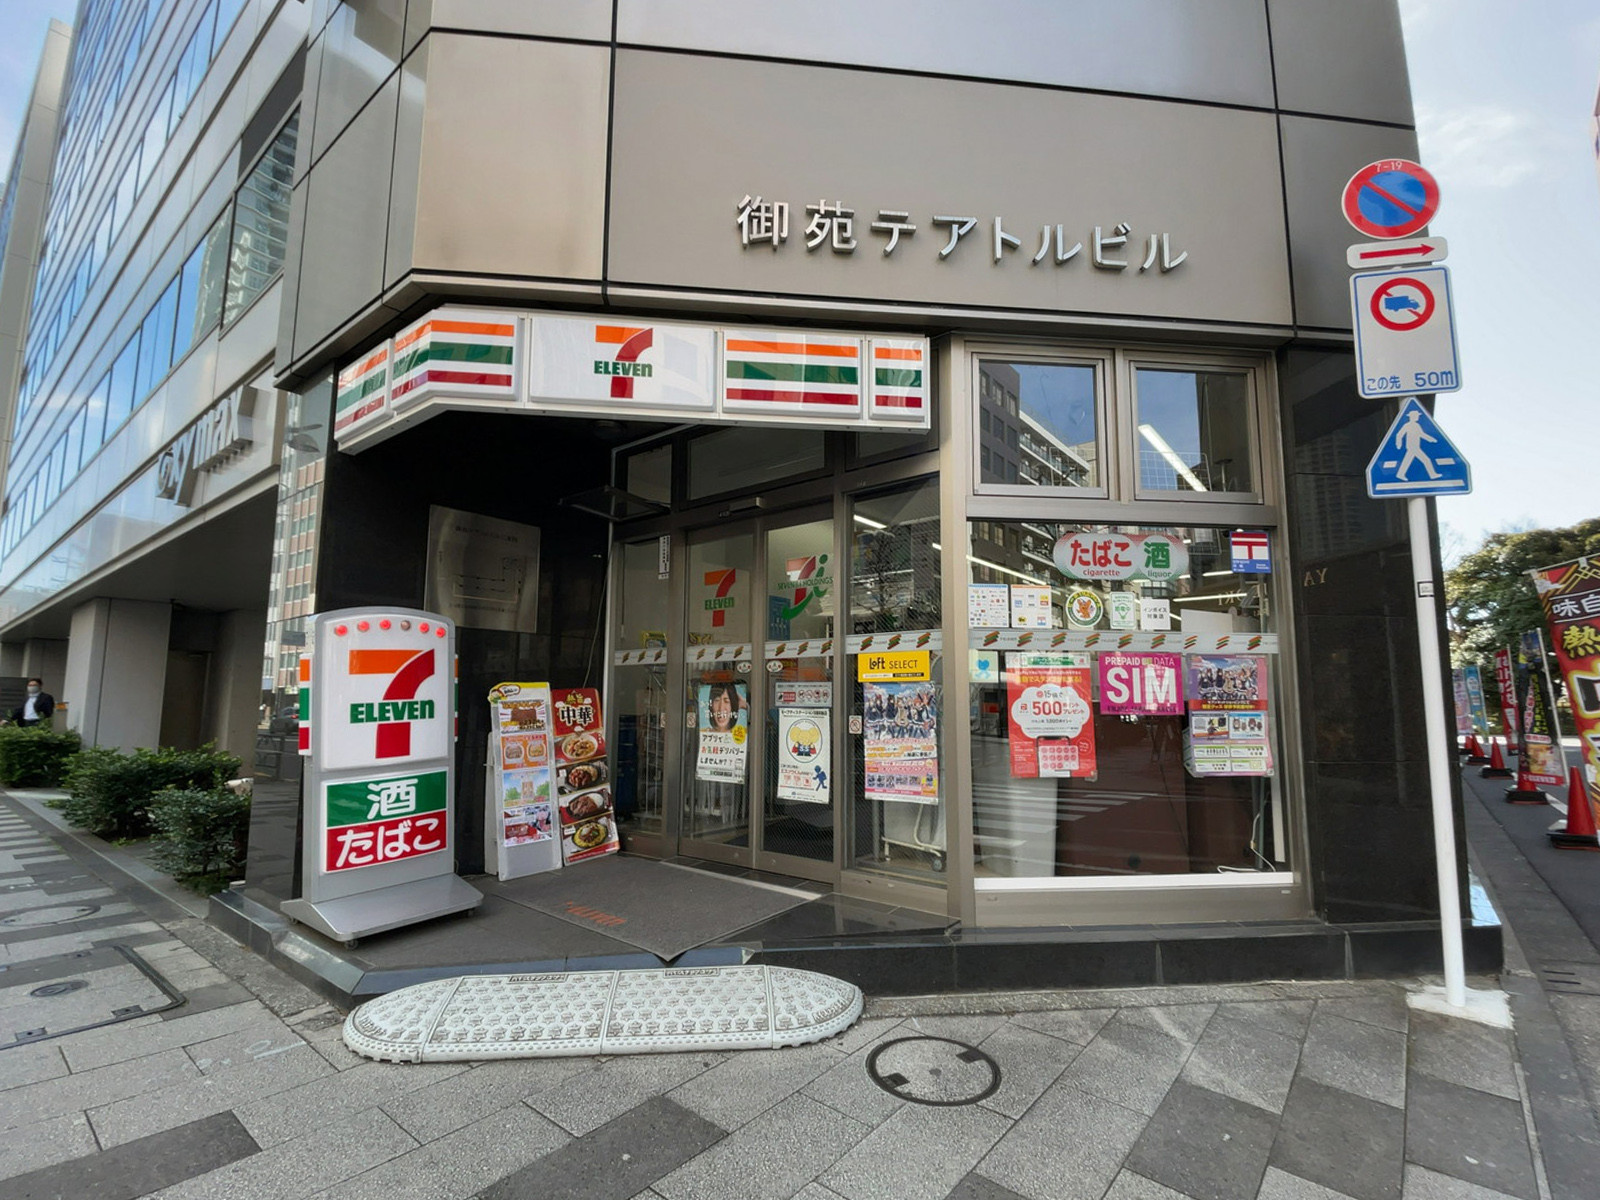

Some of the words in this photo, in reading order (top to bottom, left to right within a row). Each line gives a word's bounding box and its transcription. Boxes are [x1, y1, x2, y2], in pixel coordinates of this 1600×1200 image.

[1374, 160, 1403, 172] 7-19
[736, 194, 1189, 272] 御苑テアトルビル
[1366, 374, 1402, 391] この先
[1414, 370, 1456, 388] 50m
[1070, 540, 1132, 568] たばこ
[1144, 541, 1171, 569] 酒
[1082, 569, 1121, 577] cigarette
[1147, 570, 1172, 579] liquor
[888, 659, 918, 669] SELECT
[1104, 656, 1141, 666] PREPAID
[1153, 657, 1175, 666] DATA
[1106, 666, 1177, 704] SIM
[560, 705, 594, 727] 中華
[1032, 700, 1063, 716] 500
[367, 778, 418, 820] 酒
[336, 818, 441, 867] たばこ
